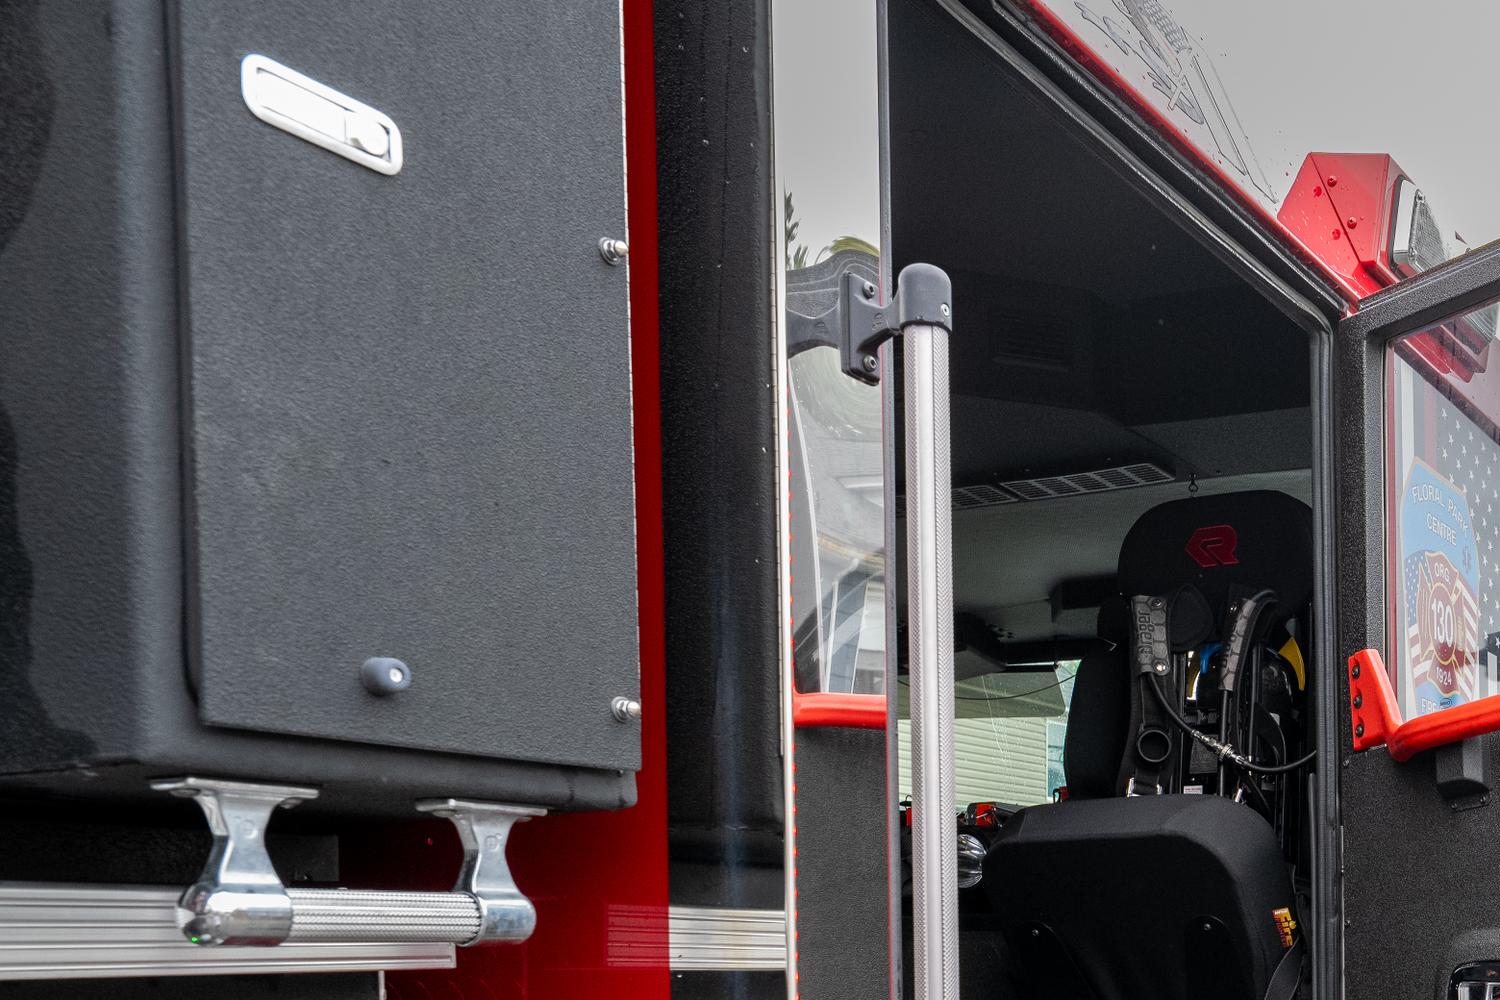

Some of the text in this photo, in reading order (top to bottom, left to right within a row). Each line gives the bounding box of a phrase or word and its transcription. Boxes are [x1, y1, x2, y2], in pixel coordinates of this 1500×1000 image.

[1412, 484, 1468, 537] FLORAL PARK
[1426, 511, 1457, 547] CENTRE
[1431, 598, 1454, 648] 130
[1436, 666, 1452, 686] 1924
